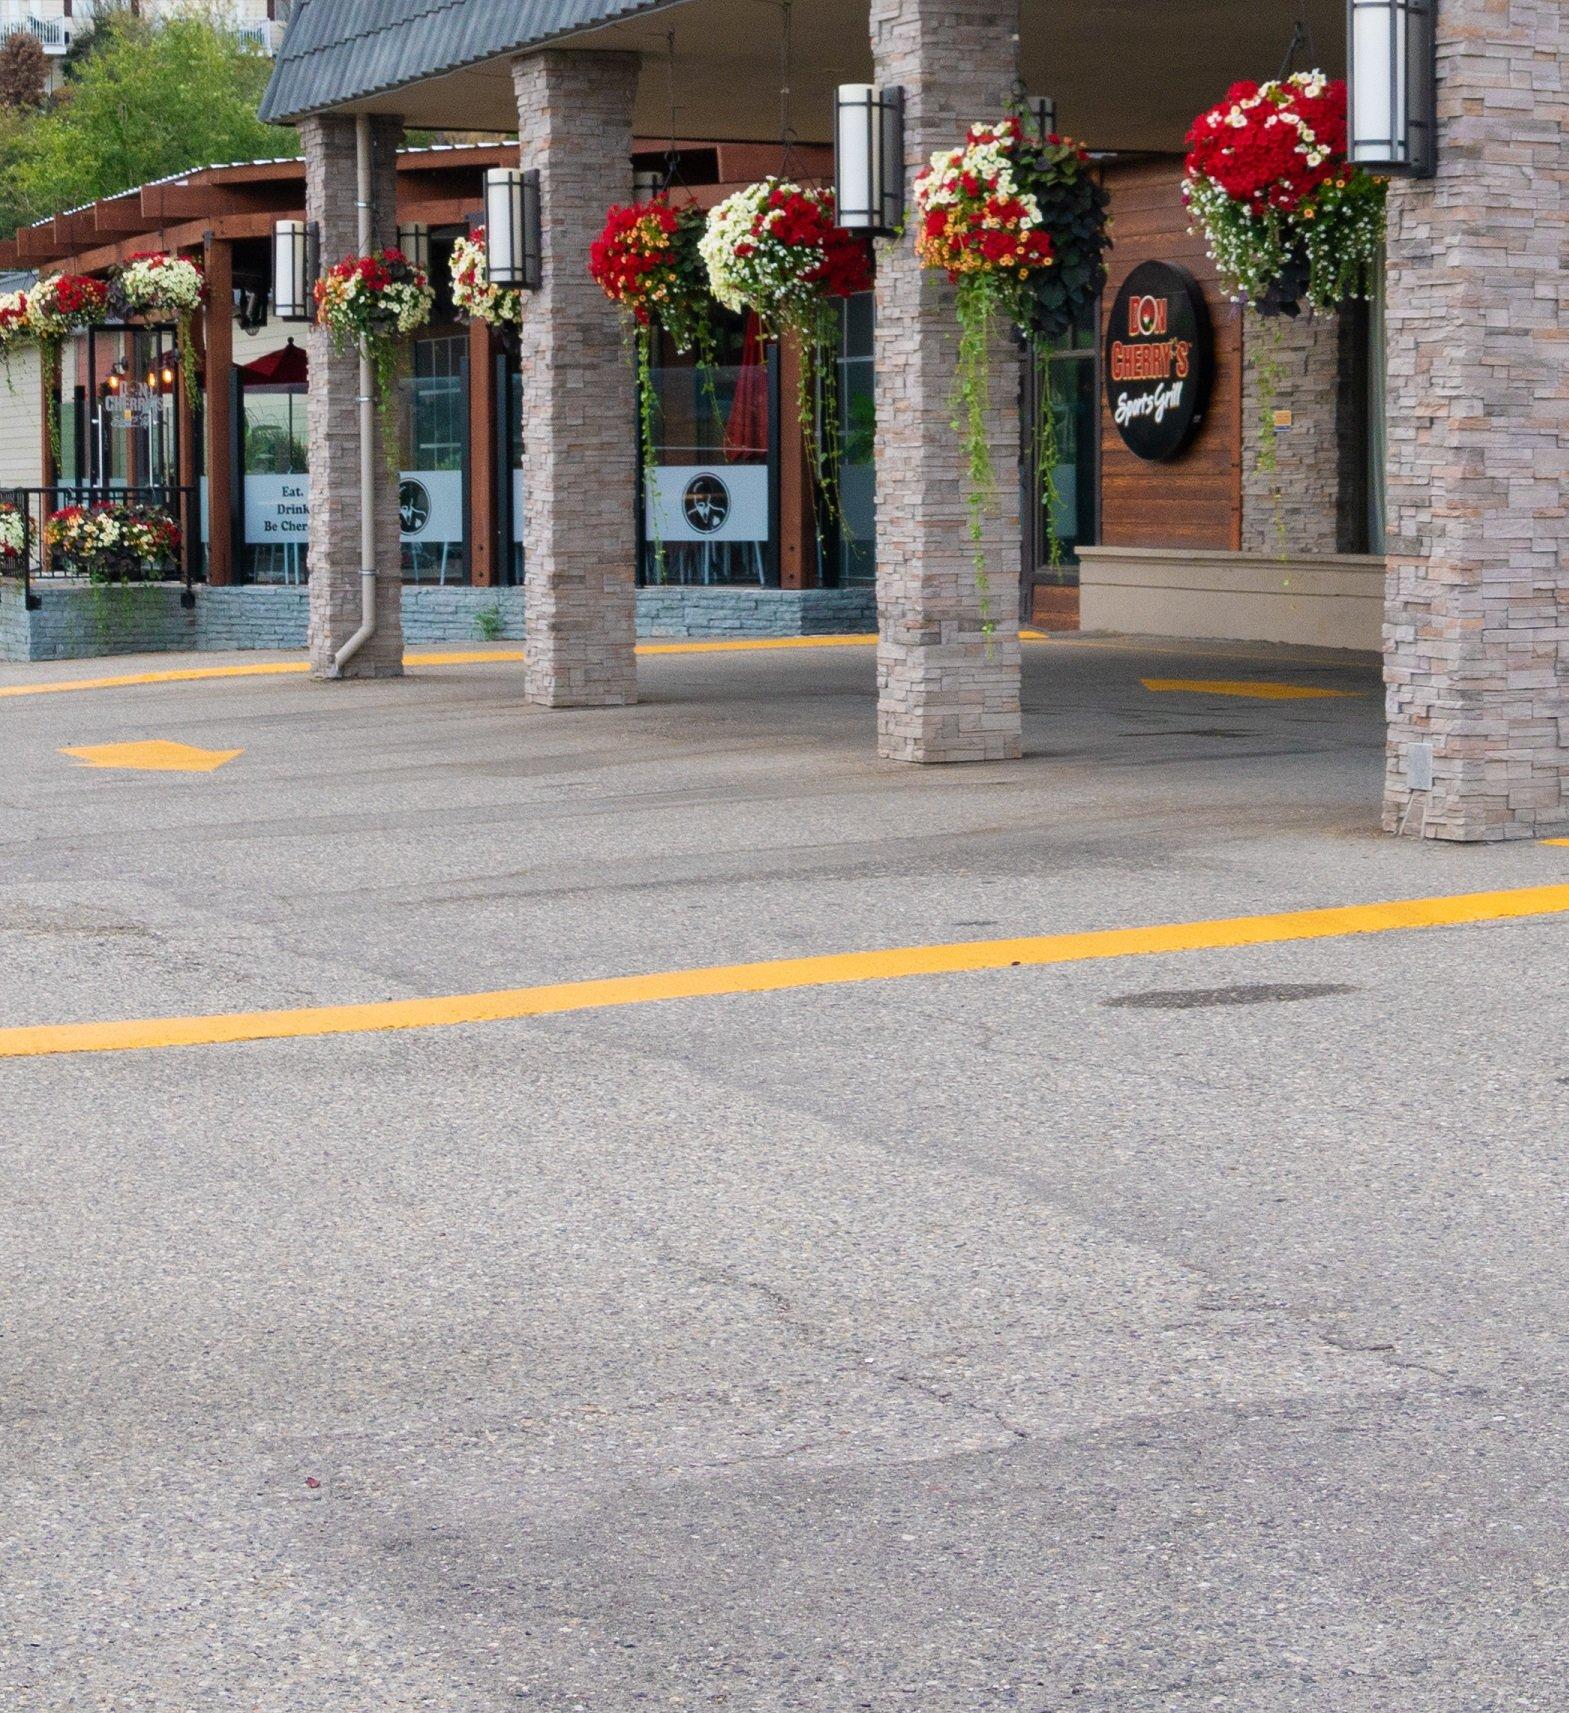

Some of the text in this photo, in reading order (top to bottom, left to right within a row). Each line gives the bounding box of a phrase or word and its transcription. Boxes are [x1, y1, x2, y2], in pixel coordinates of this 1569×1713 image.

[1128, 295, 1168, 337] DON
[1111, 338, 1189, 380] CHERRY'S
[120, 380, 149, 397] DN
[1114, 380, 1184, 427] Sports Grill
[282, 486, 304, 497] Eat.
[277, 503, 310, 515] Drink
[264, 520, 309, 532] Be Cher
